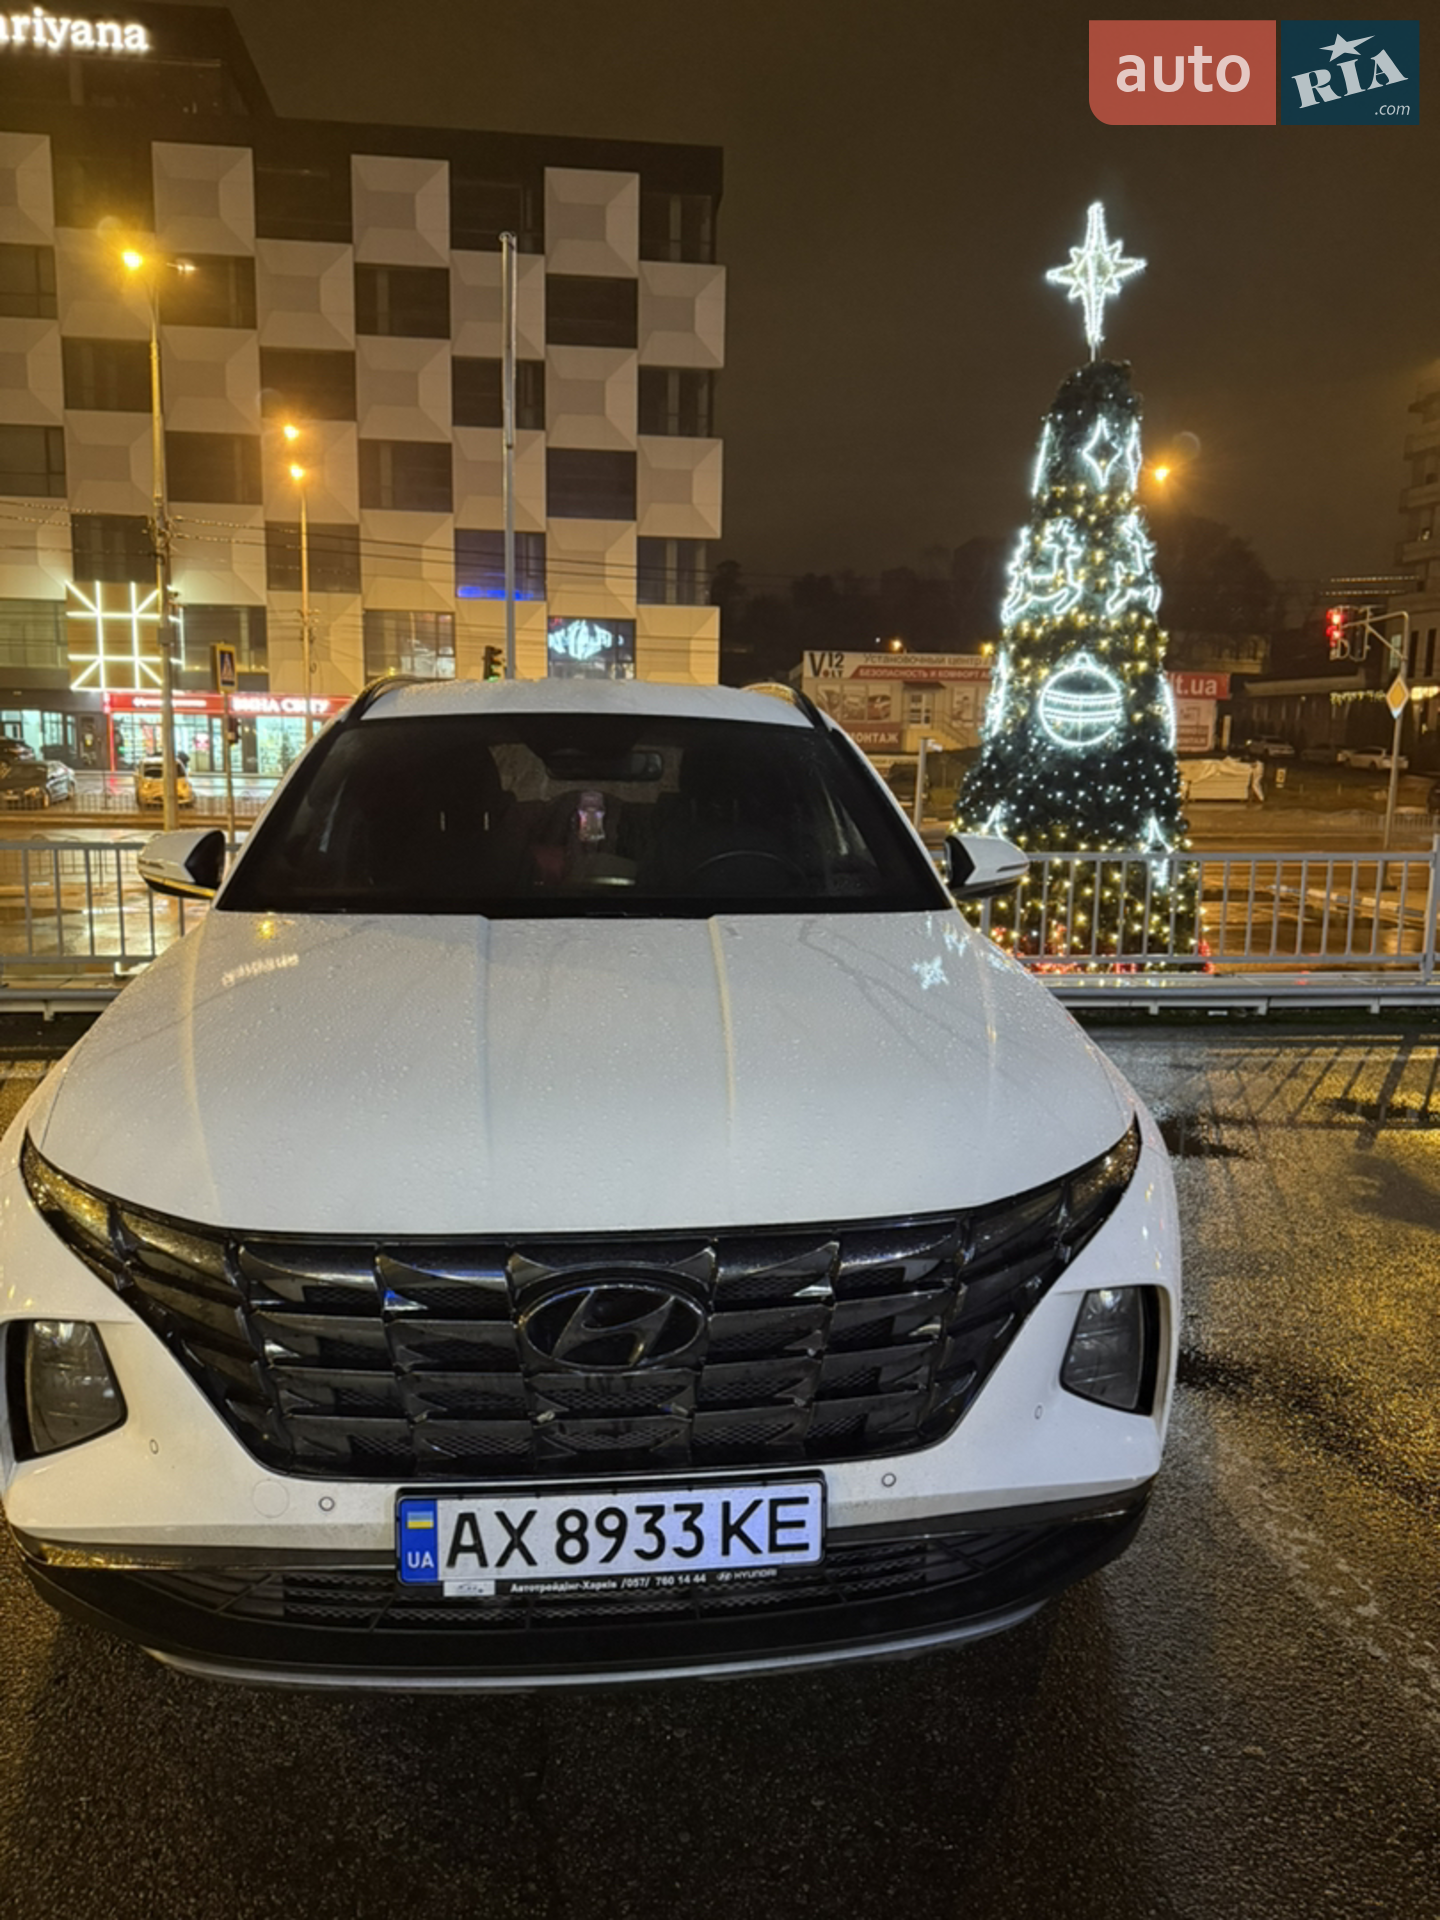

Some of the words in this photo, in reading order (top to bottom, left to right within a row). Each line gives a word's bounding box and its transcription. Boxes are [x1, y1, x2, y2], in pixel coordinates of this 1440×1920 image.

[859, 668, 928, 678] БЕЗОПАСНОСТЬ
[407, 1551, 435, 1569] UA
[446, 1509, 538, 1568] AX
[555, 1502, 704, 1565] 8933
[721, 1496, 810, 1556] KE
[655, 1576, 675, 1586] 760
[678, 1575, 691, 1585] 14
[693, 1573, 707, 1583] 44
[733, 1568, 778, 1580] HYUNDAI
